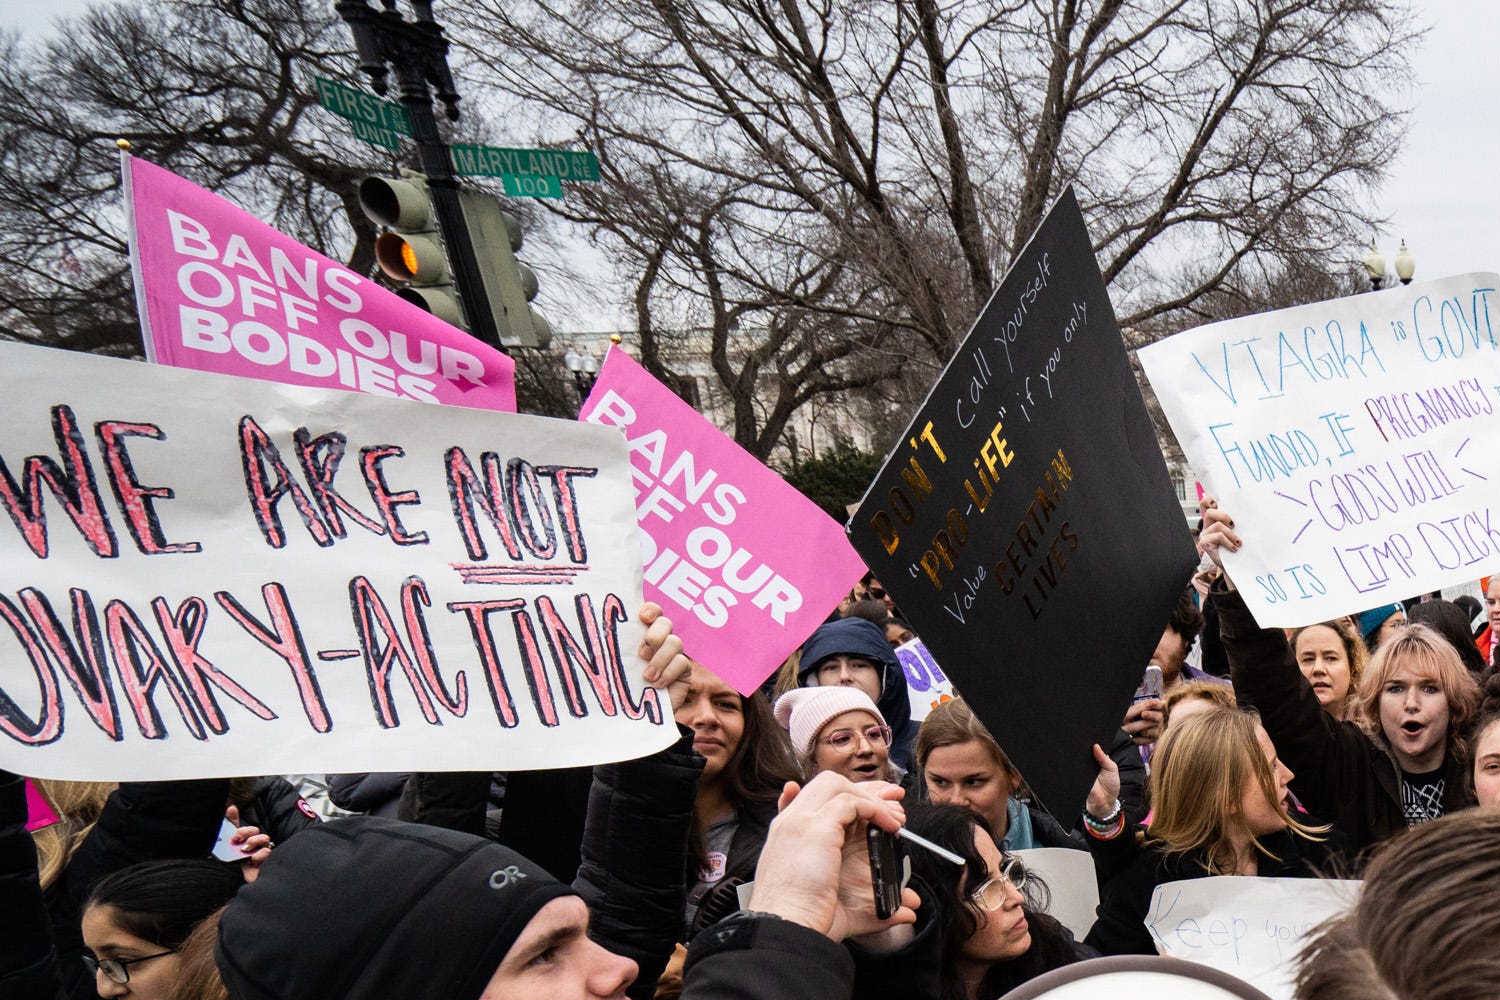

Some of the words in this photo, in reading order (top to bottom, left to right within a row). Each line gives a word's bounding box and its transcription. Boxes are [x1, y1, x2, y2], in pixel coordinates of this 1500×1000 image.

[319, 81, 387, 127] FIRST
[391, 107, 403, 120] ST
[357, 122, 395, 149] UNIT
[459, 148, 569, 178] MARYLAND
[572, 153, 588, 167] AV
[514, 177, 549, 195] 100
[573, 166, 591, 179] NE
[167, 208, 364, 314] BANS
[177, 261, 319, 331] OFF
[339, 317, 488, 387] OUR
[179, 304, 441, 404] BODIES
[1016, 376, 1036, 423] if
[1040, 346, 1062, 399] you
[1064, 300, 1089, 343] only
[1191, 319, 1386, 407] VIAGRA
[870, 420, 947, 557] DON'T
[994, 251, 1052, 374] yourself
[1209, 422, 1334, 489] FUNDED,
[1318, 411, 1355, 456] IF
[1363, 377, 1493, 443] PREGNANCY
[0, 404, 203, 559] WE
[238, 415, 430, 548] ARE
[444, 446, 599, 565] NOT
[586, 388, 747, 526] BANS
[1387, 449, 1464, 508] WILL
[686, 526, 803, 627] OUR
[943, 563, 988, 626] Value
[994, 448, 1075, 597] CERTAIN
[1021, 520, 1081, 621] LIVES
[1255, 574, 1287, 604] SO
[1284, 563, 1327, 600] IS
[1333, 532, 1413, 594] LIMP
[490, 865, 528, 890] OR
[1149, 889, 1248, 966] Keep
